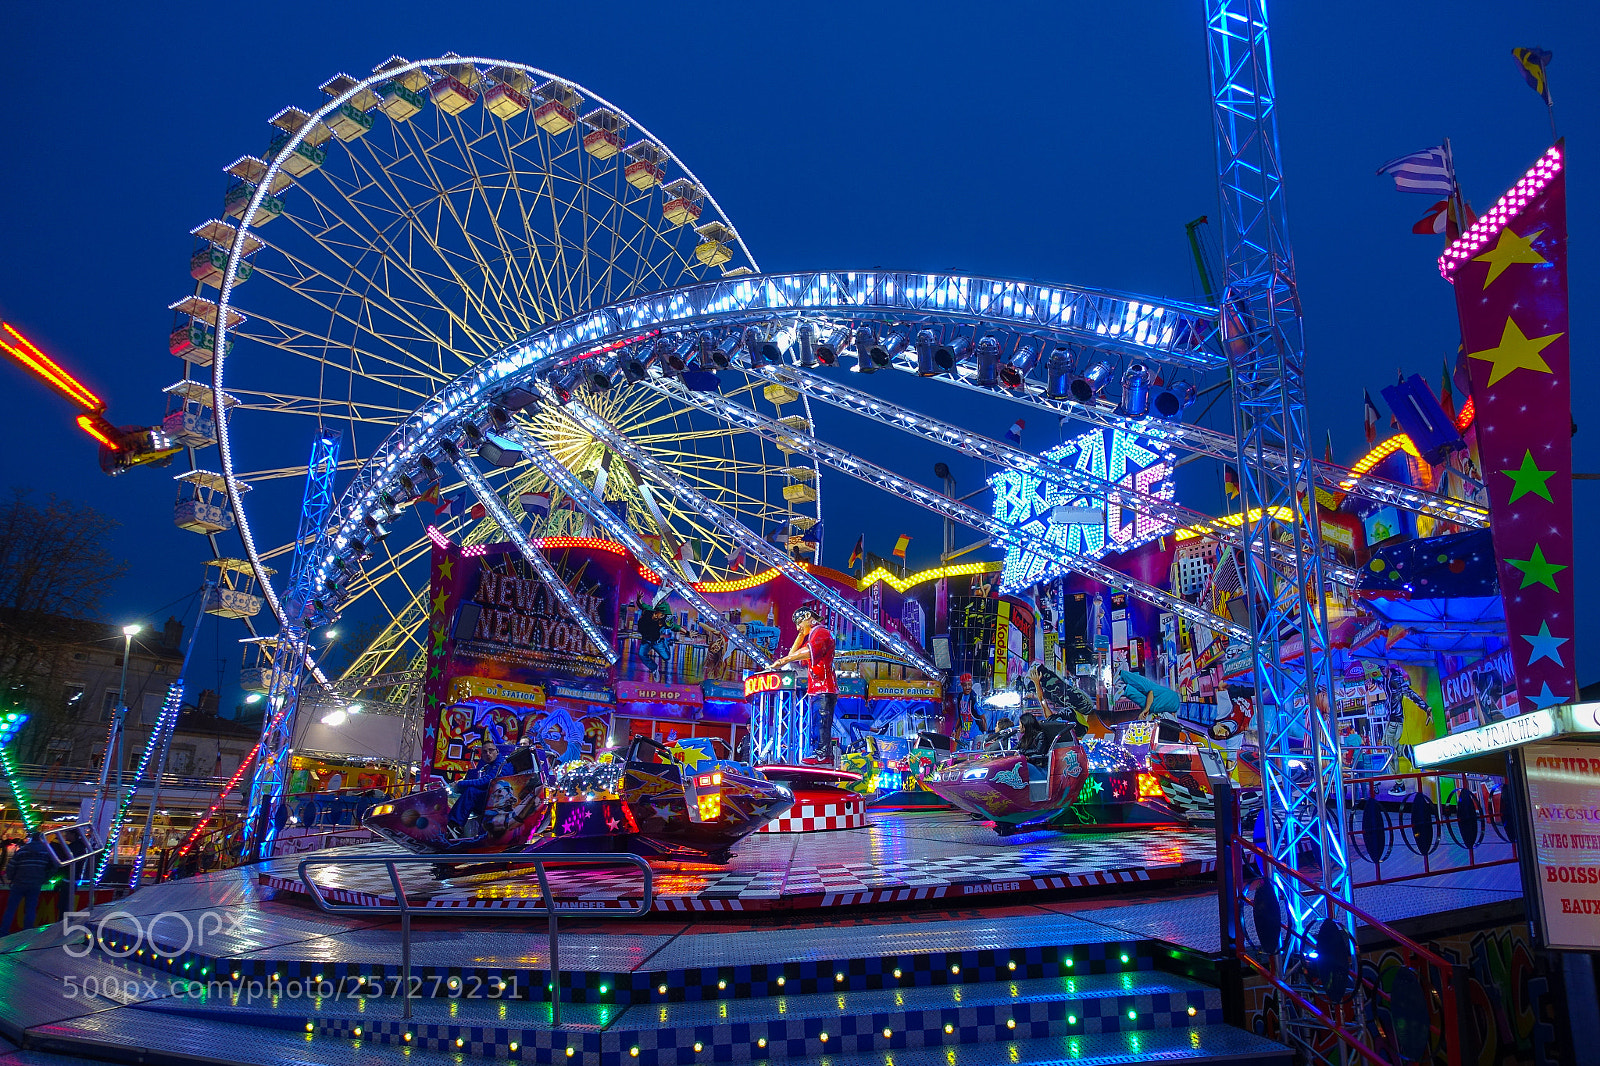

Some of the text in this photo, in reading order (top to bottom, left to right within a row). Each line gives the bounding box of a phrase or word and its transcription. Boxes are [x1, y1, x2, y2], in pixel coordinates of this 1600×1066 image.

[477, 569, 540, 612] NEW
[474, 607, 537, 647] NEW
[996, 623, 1007, 665] Kodak
[486, 687, 536, 701] DJ STATION
[638, 690, 681, 700] HIP HOP
[877, 686, 935, 696] DANCE PALACE
[1542, 833, 1569, 849] AVEC
[1545, 865, 1600, 884] BOISS
[963, 882, 1020, 895] DANGER
